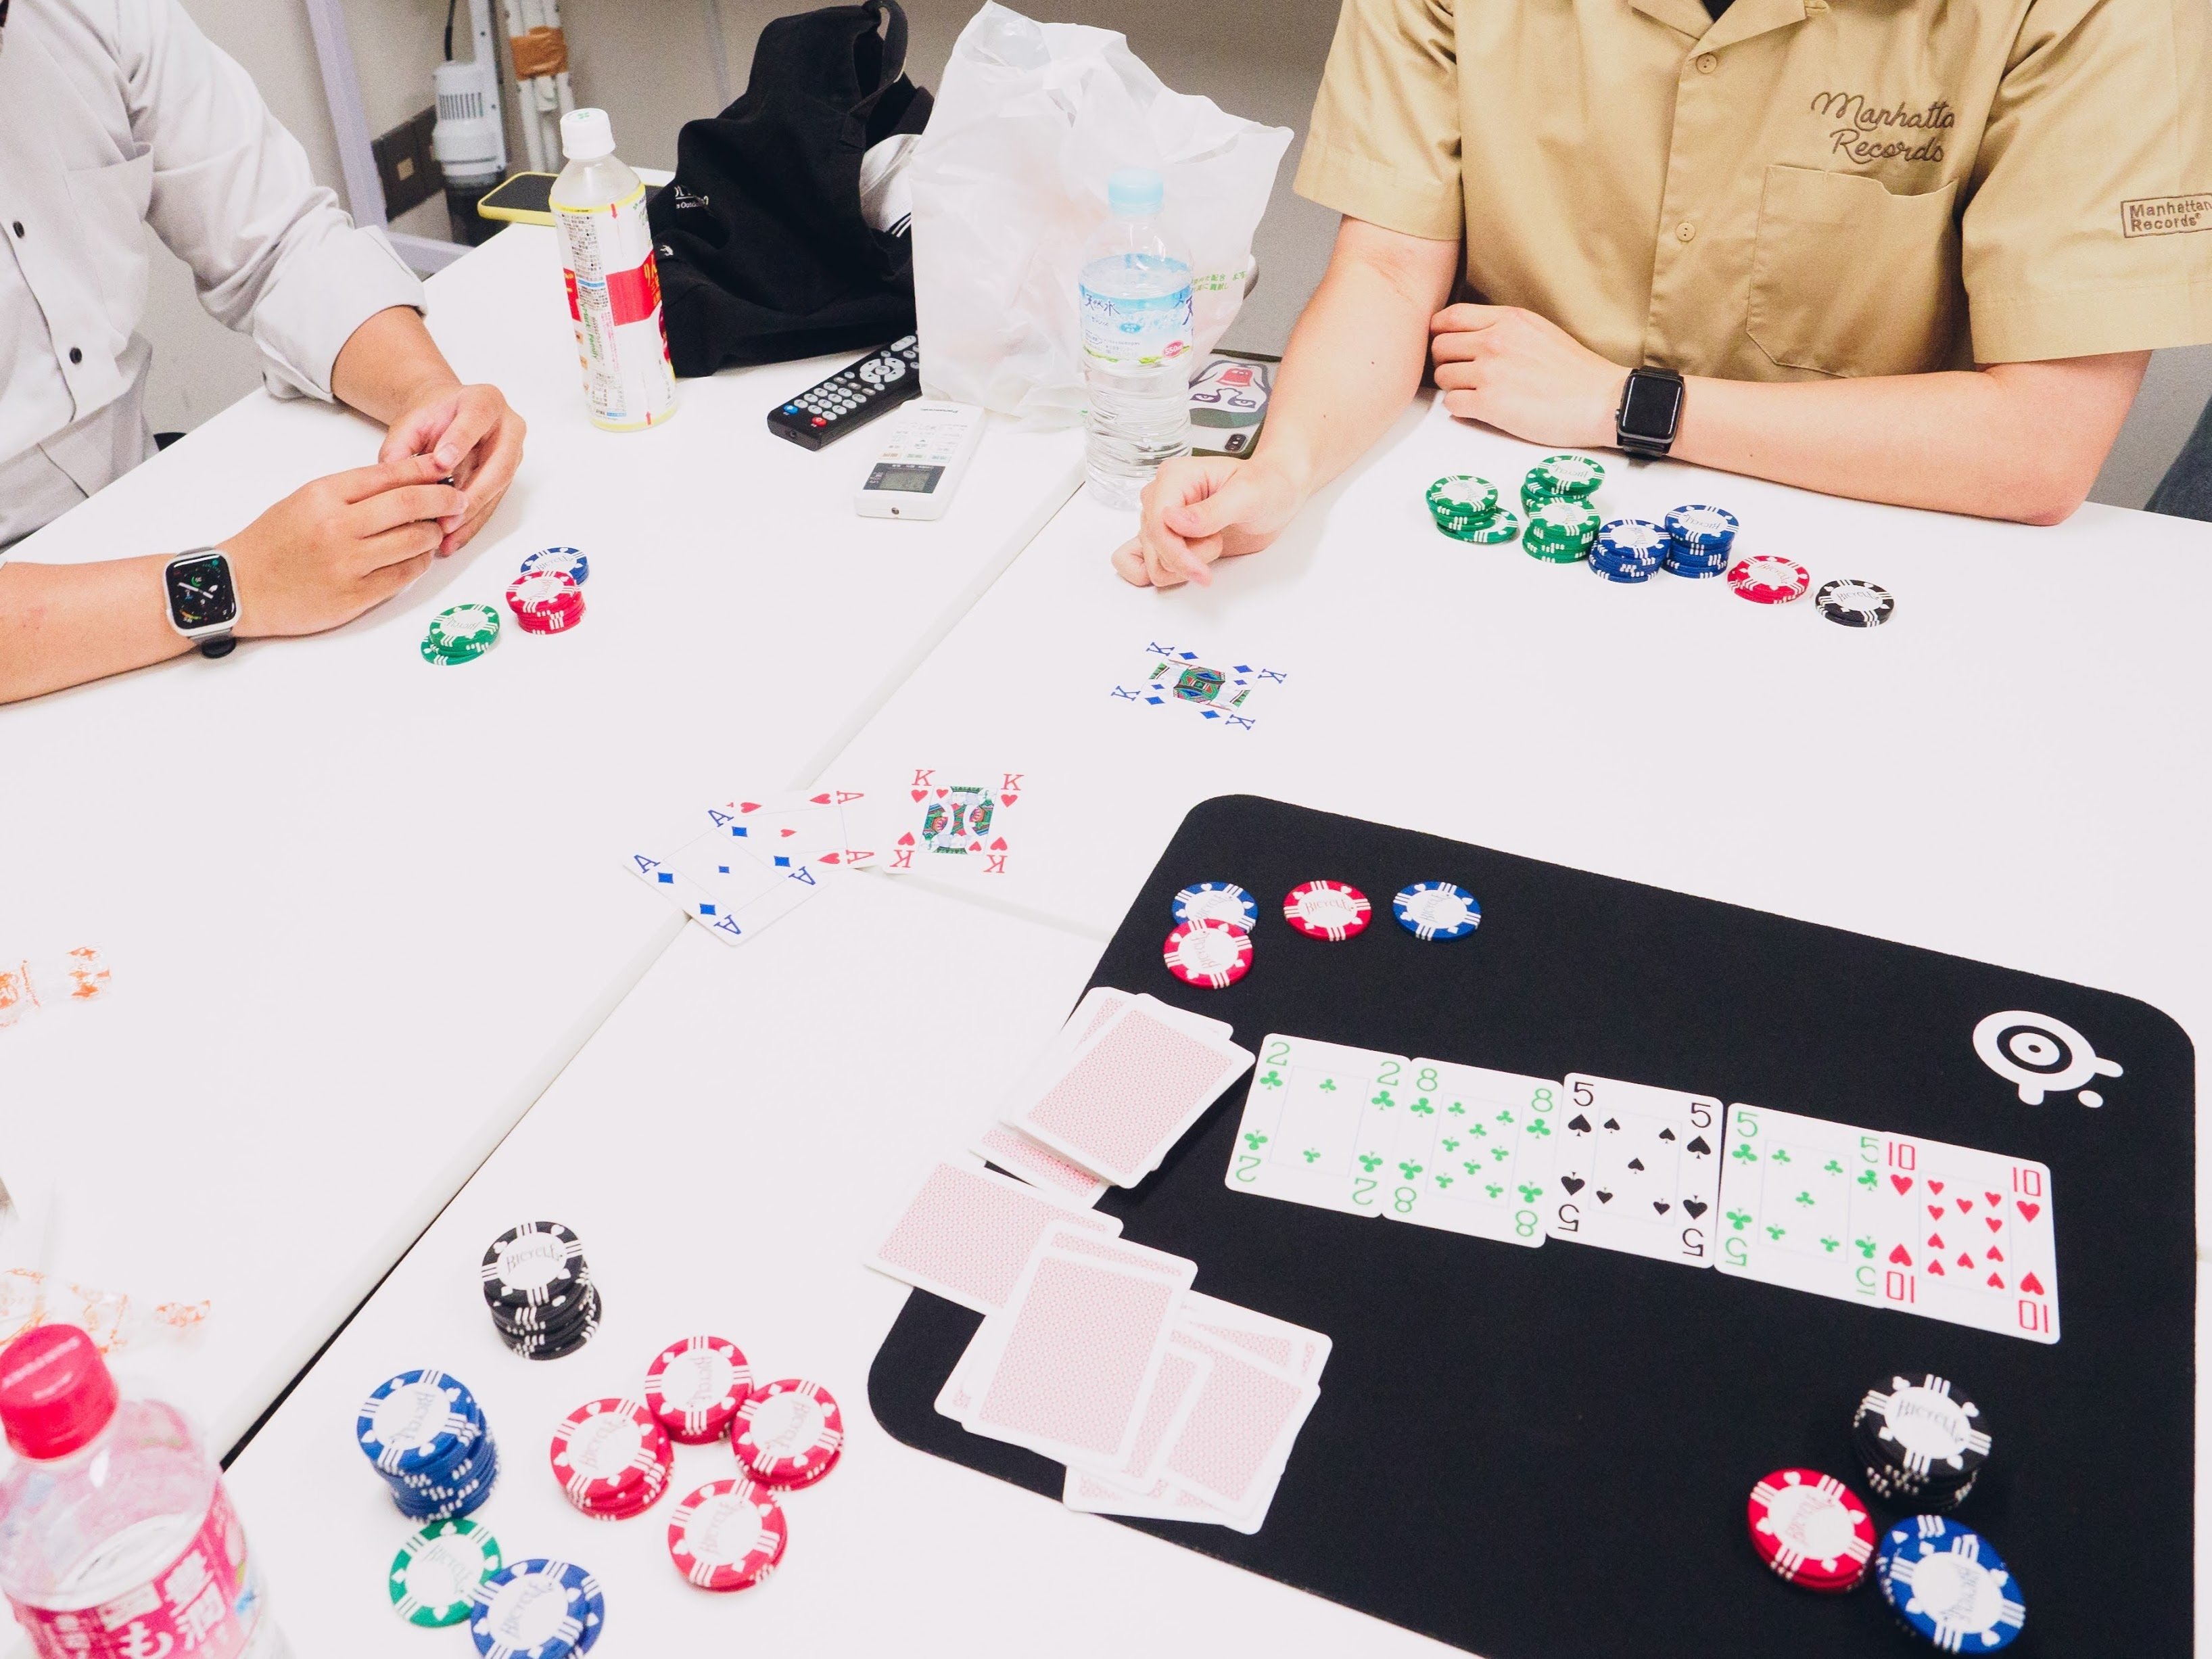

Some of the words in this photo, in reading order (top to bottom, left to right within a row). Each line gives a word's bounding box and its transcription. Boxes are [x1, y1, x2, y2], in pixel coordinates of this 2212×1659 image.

[1810, 91, 1955, 131] Manhatta
[1829, 128, 1944, 164] Records
[2129, 200, 2212, 218] Manhattan
[1146, 642, 1175, 657] K
[1258, 668, 1288, 684] K
[1110, 685, 1142, 701] K
[1225, 714, 1256, 730] K
[912, 769, 936, 787] K
[1001, 773, 1025, 791] K
[836, 790, 864, 805] A
[707, 809, 734, 827] A
[634, 854, 660, 873] A
[846, 849, 875, 864] A
[889, 849, 916, 869] K
[983, 855, 1009, 874] K
[789, 866, 817, 887] A
[713, 914, 743, 935] A
[1266, 1042, 1291, 1067] 2
[1376, 1061, 1401, 1086] 2
[1416, 1068, 1438, 1092] 8
[1531, 1088, 1553, 1113] 8
[1573, 1081, 1595, 1107] 5
[1690, 1102, 1712, 1129] 5
[1736, 1111, 1759, 1139] 5
[1860, 1136, 1879, 1164] 5
[1887, 1141, 1916, 1171] 10
[1236, 1154, 1262, 1183] 2
[1352, 1177, 1378, 1206] 2
[2012, 1166, 2042, 1198] 10
[1394, 1186, 1417, 1213] 8
[1515, 1209, 1538, 1238] 8
[1557, 1204, 1580, 1233] 5
[1682, 1228, 1705, 1258] 5
[1724, 1237, 1749, 1267] 5
[1855, 1265, 1877, 1296] 5
[1885, 1270, 1916, 1304] 10
[2018, 1299, 2049, 1334] 10
